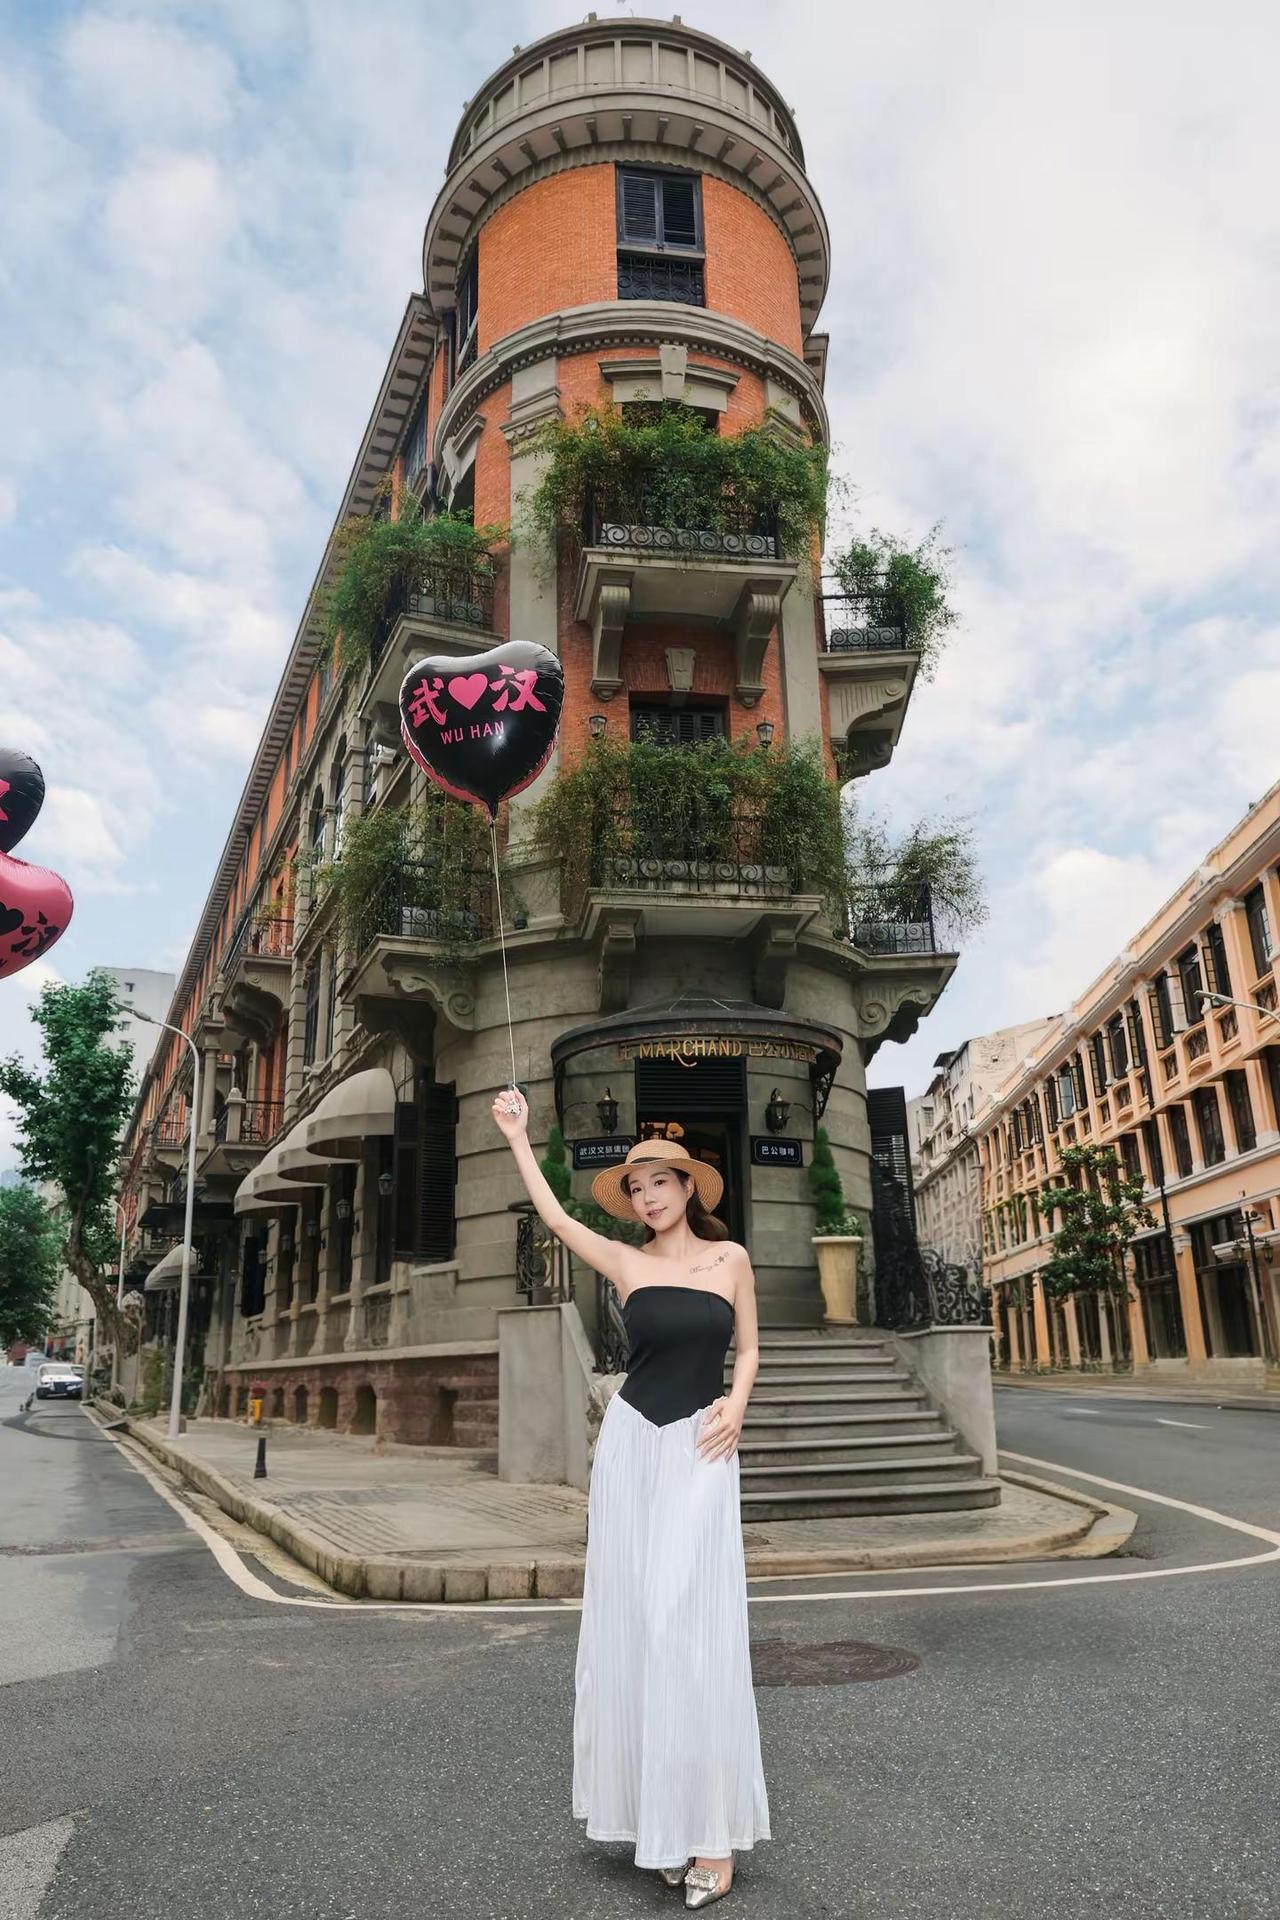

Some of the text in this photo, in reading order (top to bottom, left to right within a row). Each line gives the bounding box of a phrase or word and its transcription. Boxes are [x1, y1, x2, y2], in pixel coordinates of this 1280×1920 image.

[408, 664, 548, 728] 武 汉
[440, 720, 505, 745] WU HAN
[639, 1039, 742, 1067] MARCHAND
